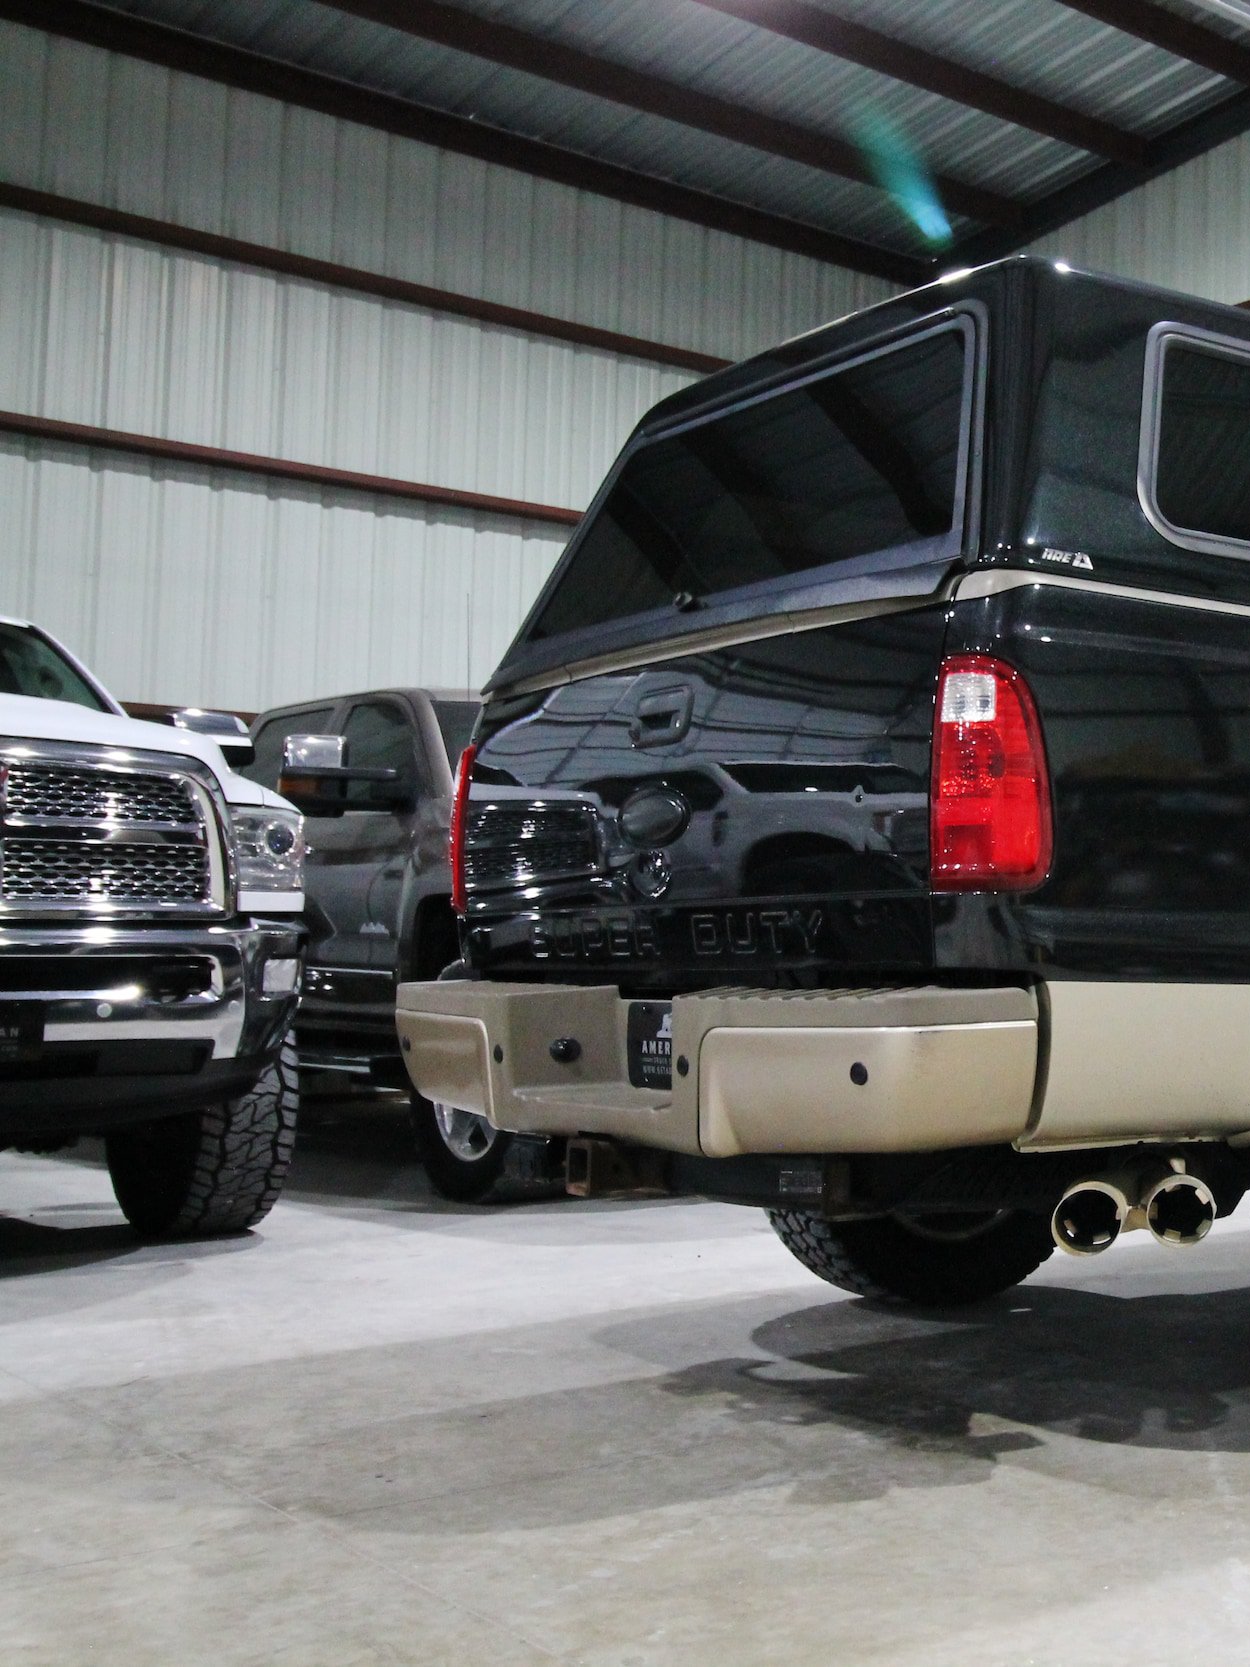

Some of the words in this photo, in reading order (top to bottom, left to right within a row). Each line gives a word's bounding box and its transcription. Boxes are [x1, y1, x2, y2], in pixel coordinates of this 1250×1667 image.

[530, 912, 662, 958] SUPER
[690, 909, 824, 956] DUTY
[641, 1040, 671, 1056] AMER
